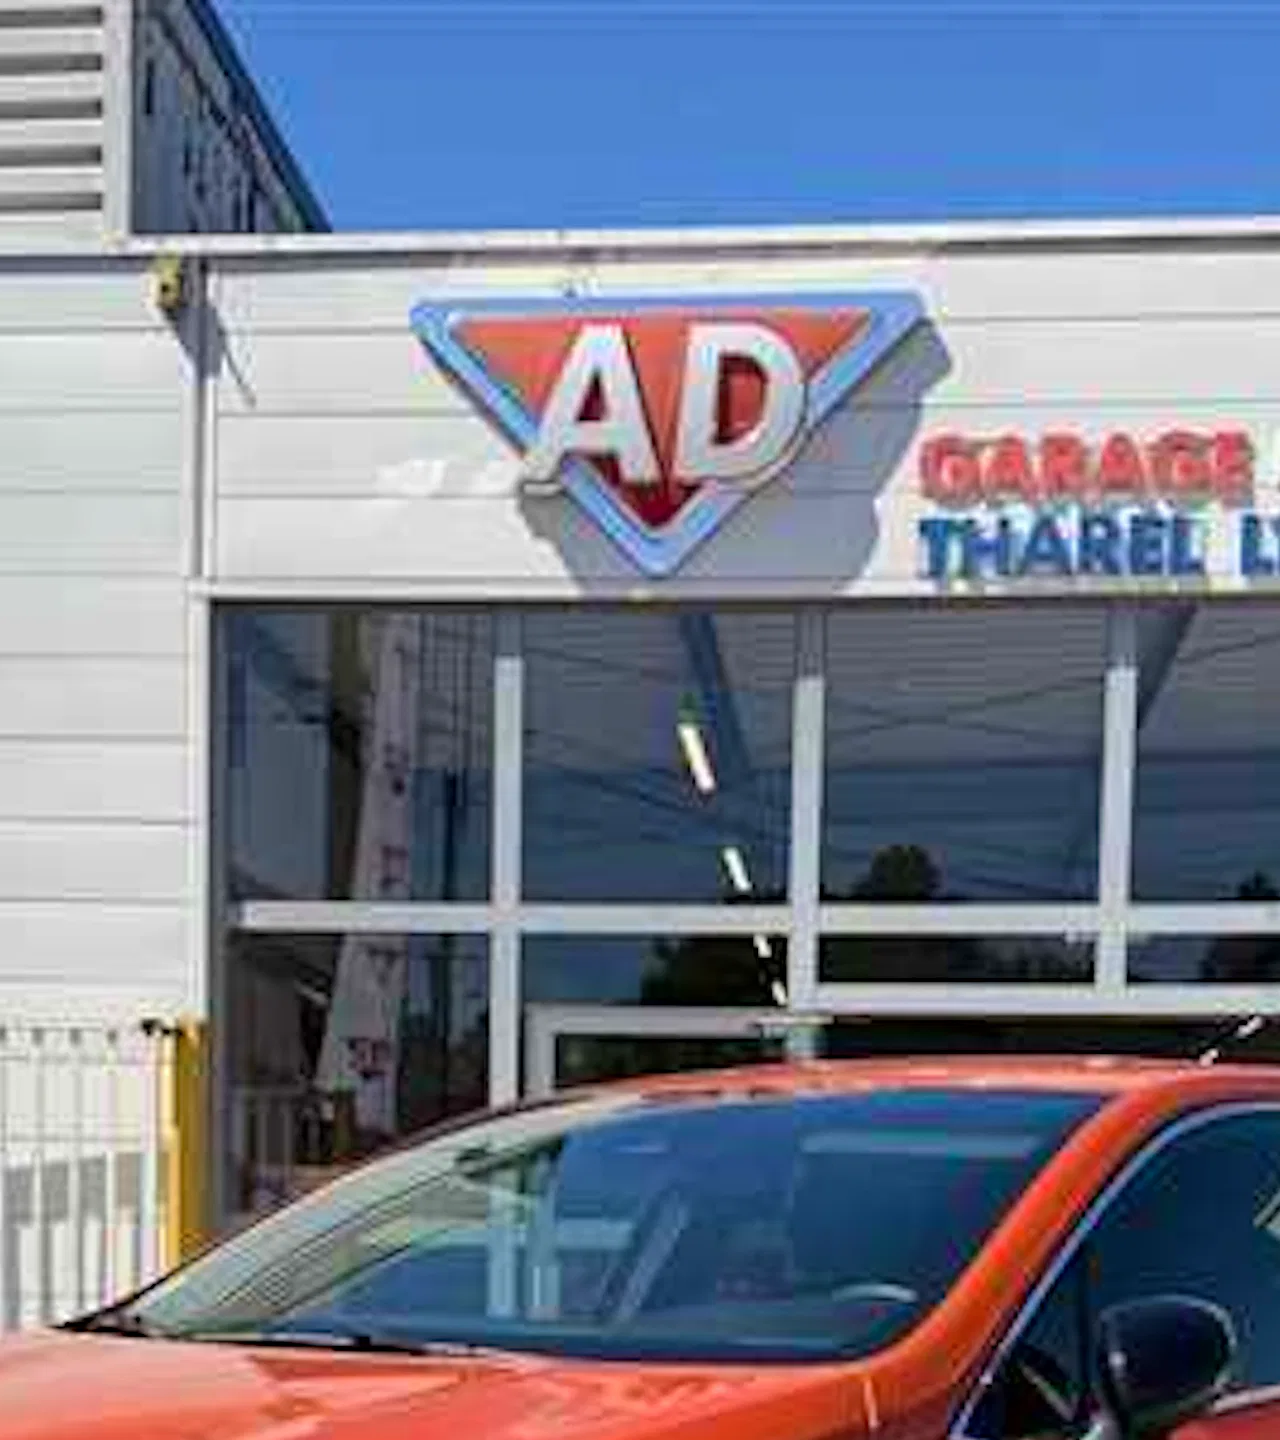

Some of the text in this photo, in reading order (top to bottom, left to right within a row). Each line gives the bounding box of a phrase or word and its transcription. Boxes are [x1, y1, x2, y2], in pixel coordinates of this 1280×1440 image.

[523, 316, 810, 494] AD
[920, 430, 1255, 504] GARAGE
[918, 512, 1206, 578] THAREL
